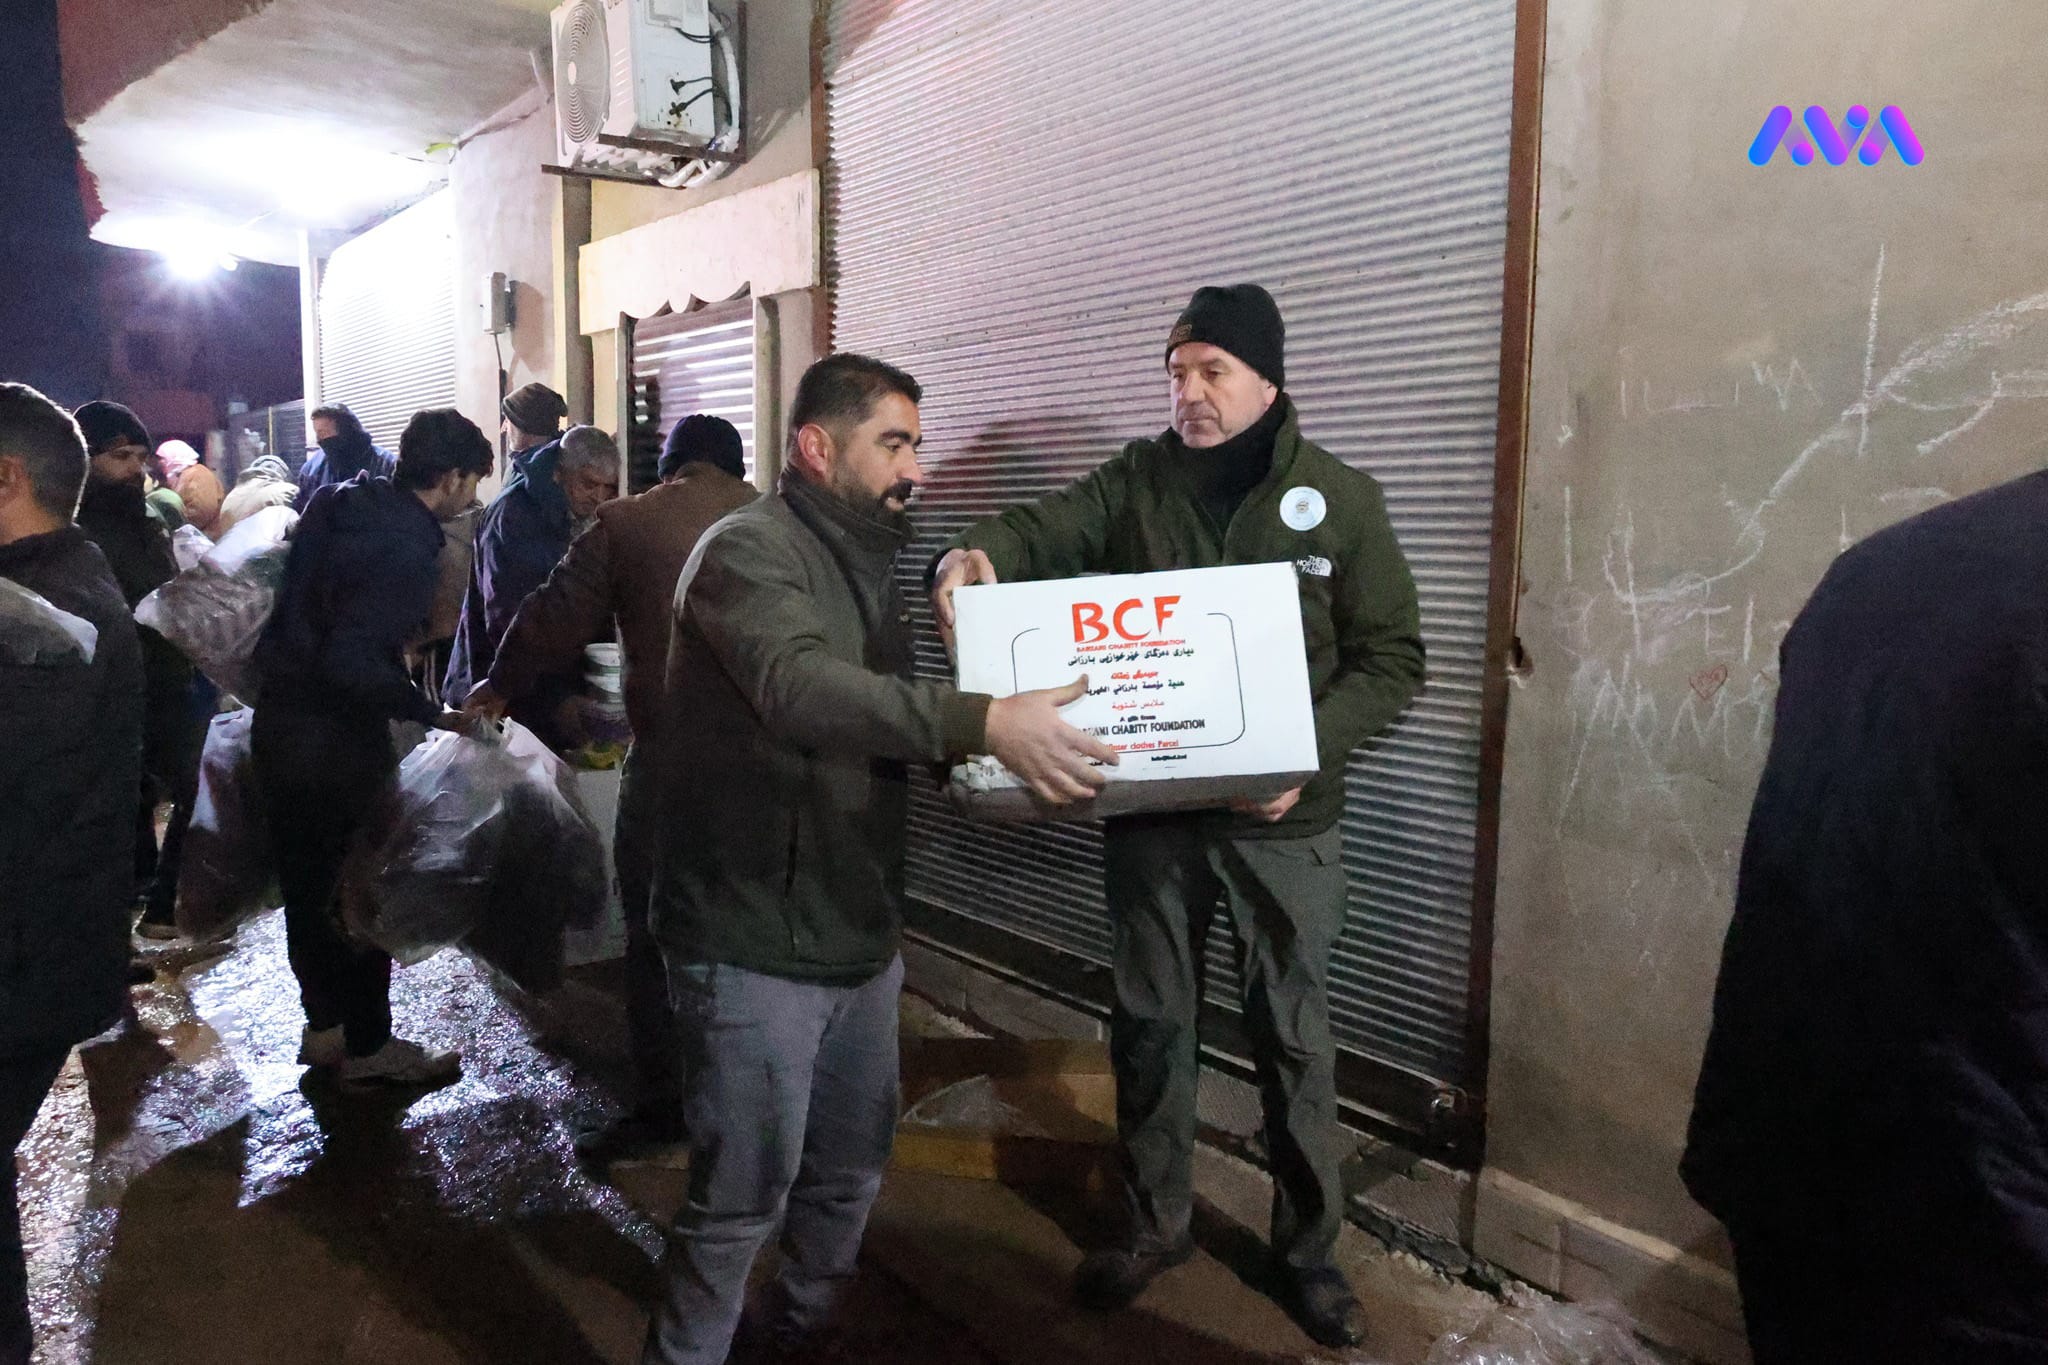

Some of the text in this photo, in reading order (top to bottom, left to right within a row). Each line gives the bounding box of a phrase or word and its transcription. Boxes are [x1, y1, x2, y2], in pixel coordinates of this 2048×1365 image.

[1071, 595, 1182, 644] BCF
[1111, 723, 1148, 735] CHARITY
[1150, 718, 1206, 733] FOUNDATION
[1157, 739, 1180, 748] Parcel
